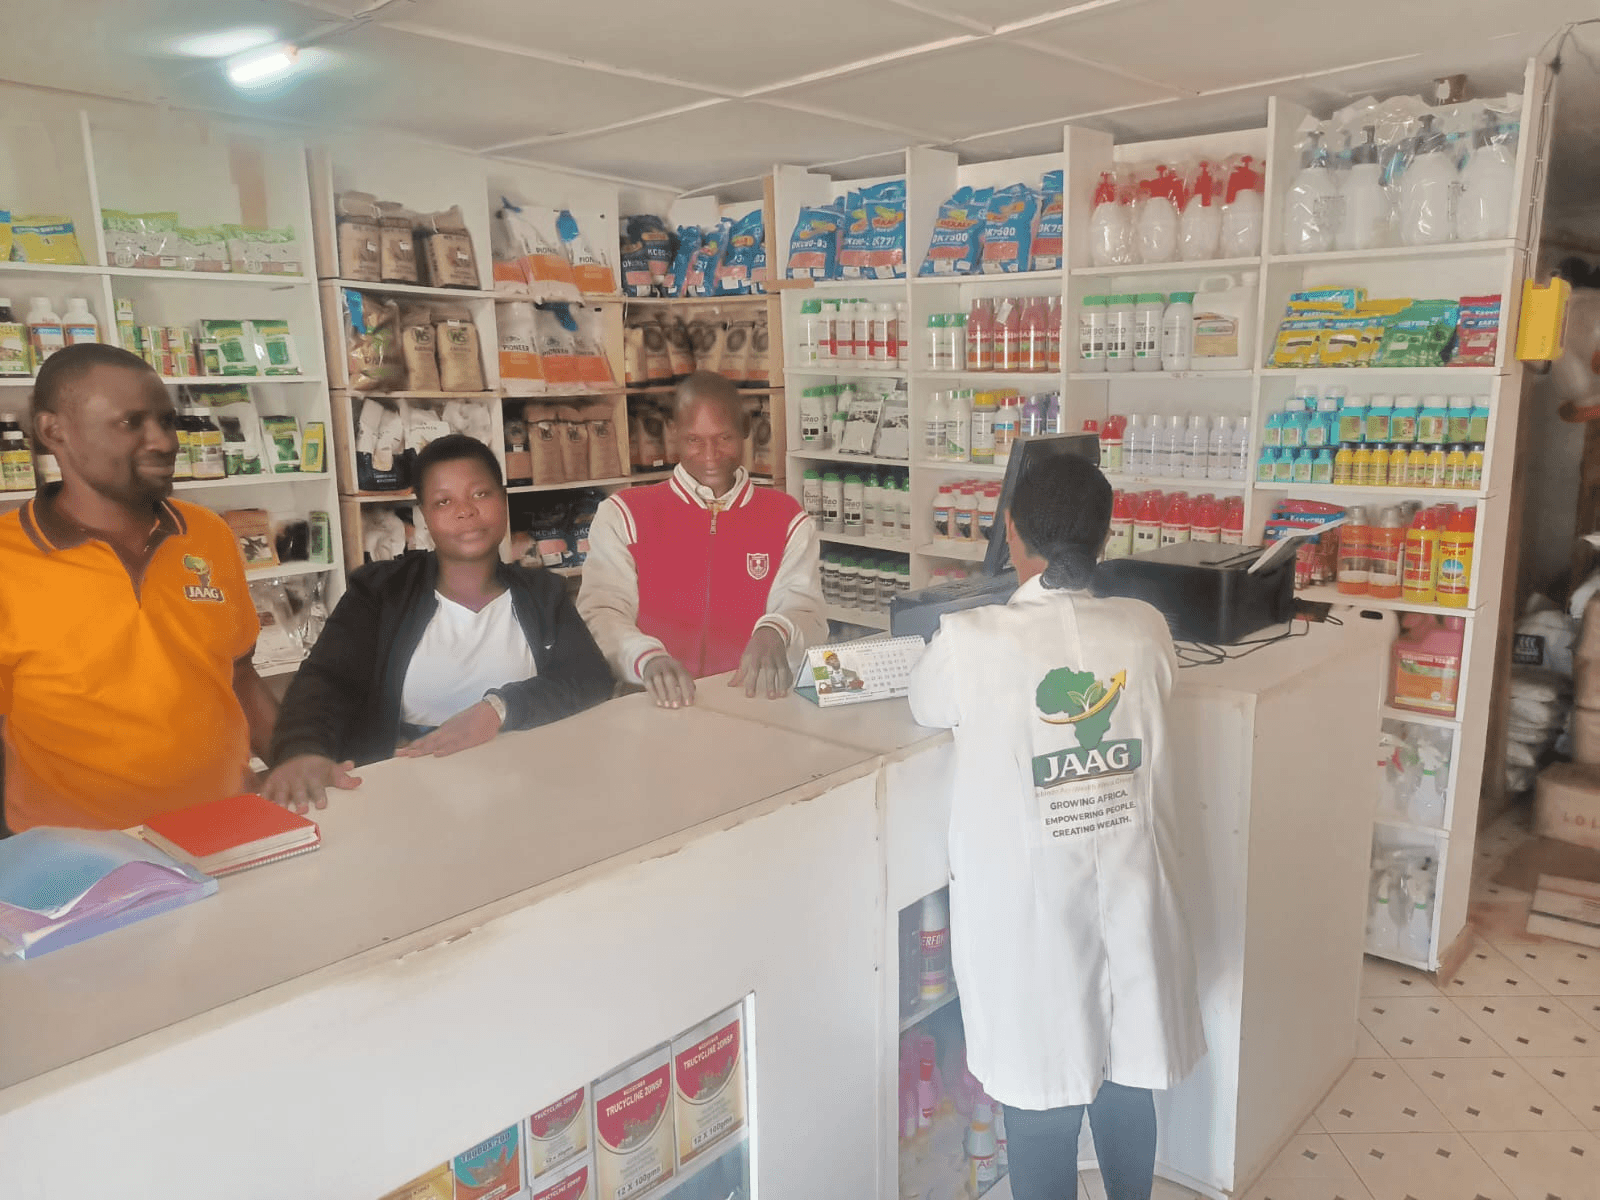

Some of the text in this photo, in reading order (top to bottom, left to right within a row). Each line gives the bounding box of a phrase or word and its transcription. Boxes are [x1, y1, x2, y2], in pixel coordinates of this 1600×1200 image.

[188, 586, 220, 599] JAAG
[1044, 743, 1130, 782] JAAG
[1045, 801, 1137, 827] EMPOWERING PEOPLE.
[1049, 796, 1096, 811] GROWING
[1052, 815, 1132, 838] CREATING WEALTH.
